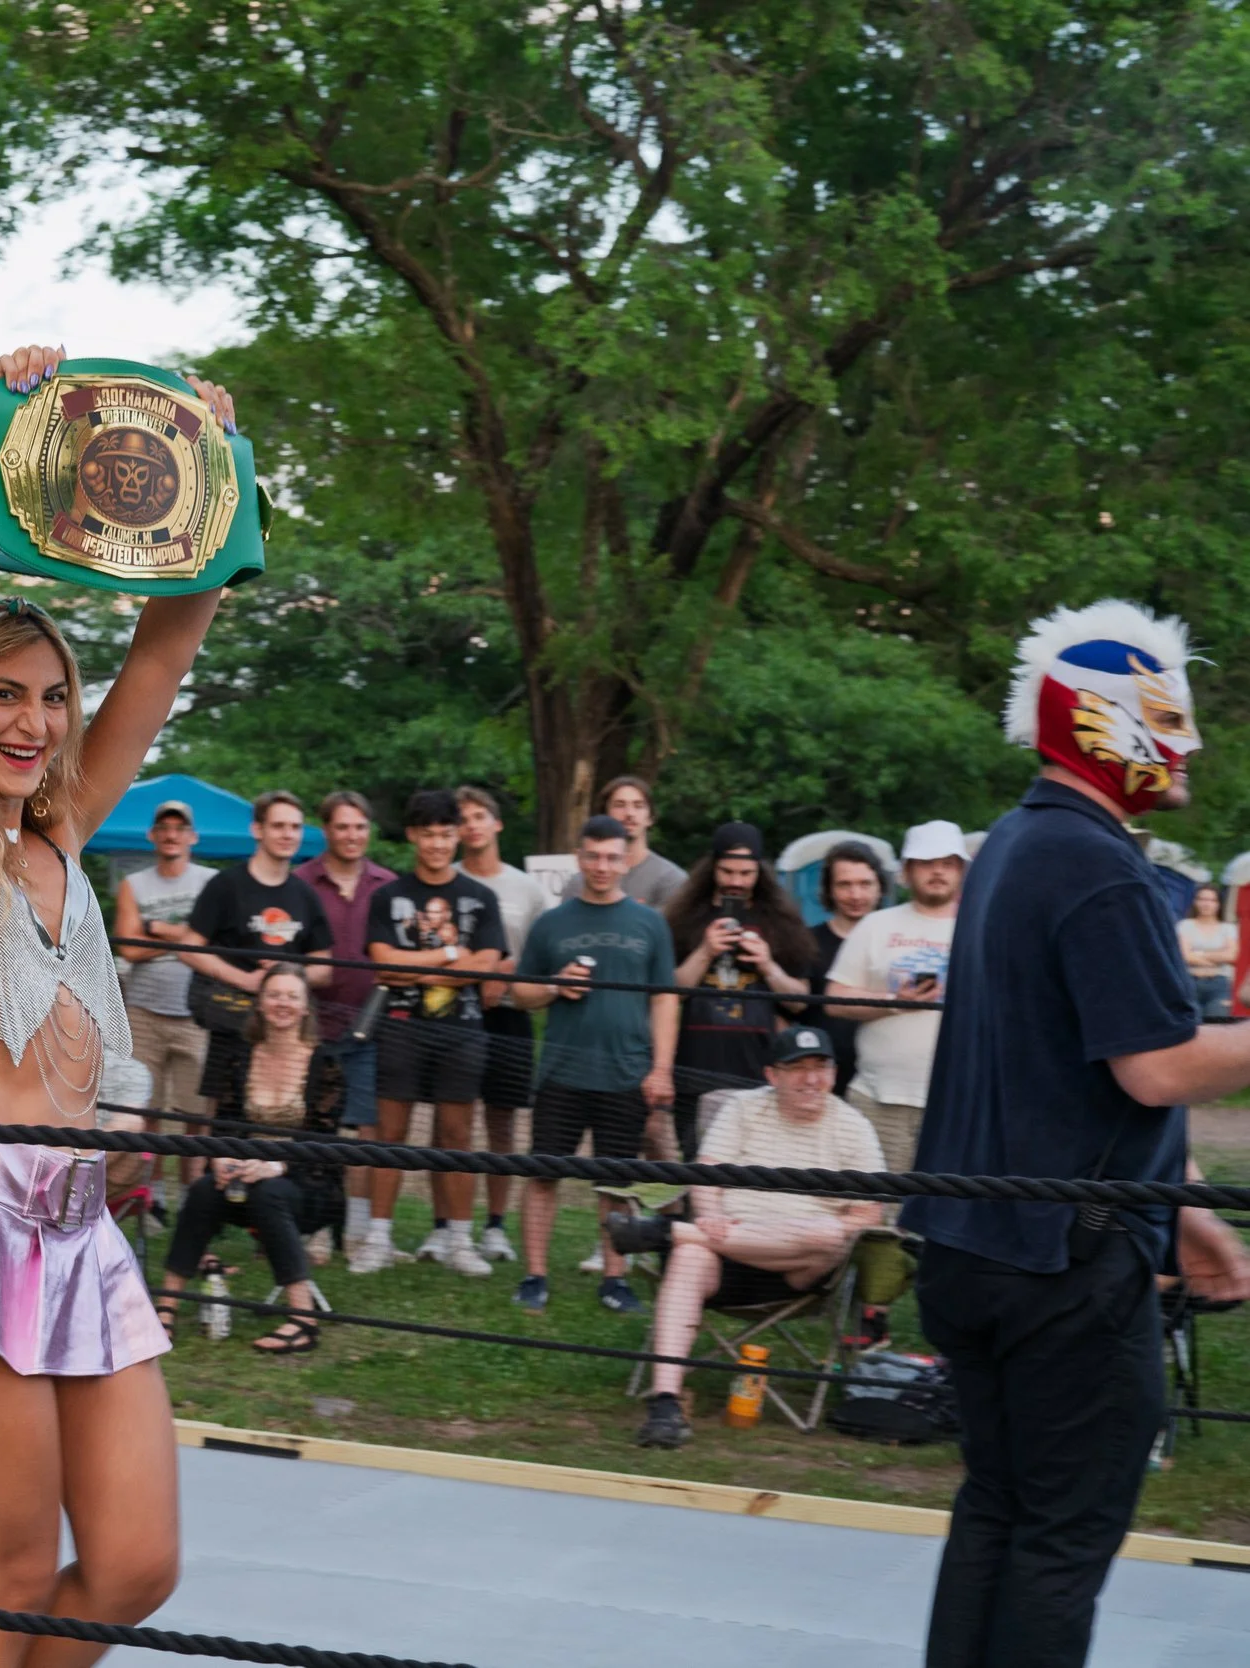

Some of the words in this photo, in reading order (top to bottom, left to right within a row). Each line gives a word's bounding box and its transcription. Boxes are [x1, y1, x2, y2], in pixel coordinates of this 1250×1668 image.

[92, 386, 177, 421] BOOCHAMANIA
[101, 409, 130, 424] NORTH
[131, 409, 169, 434] HARVEST
[143, 531, 152, 545] MI
[133, 541, 186, 567] CHAMPION
[558, 931, 649, 955] ROGUE
